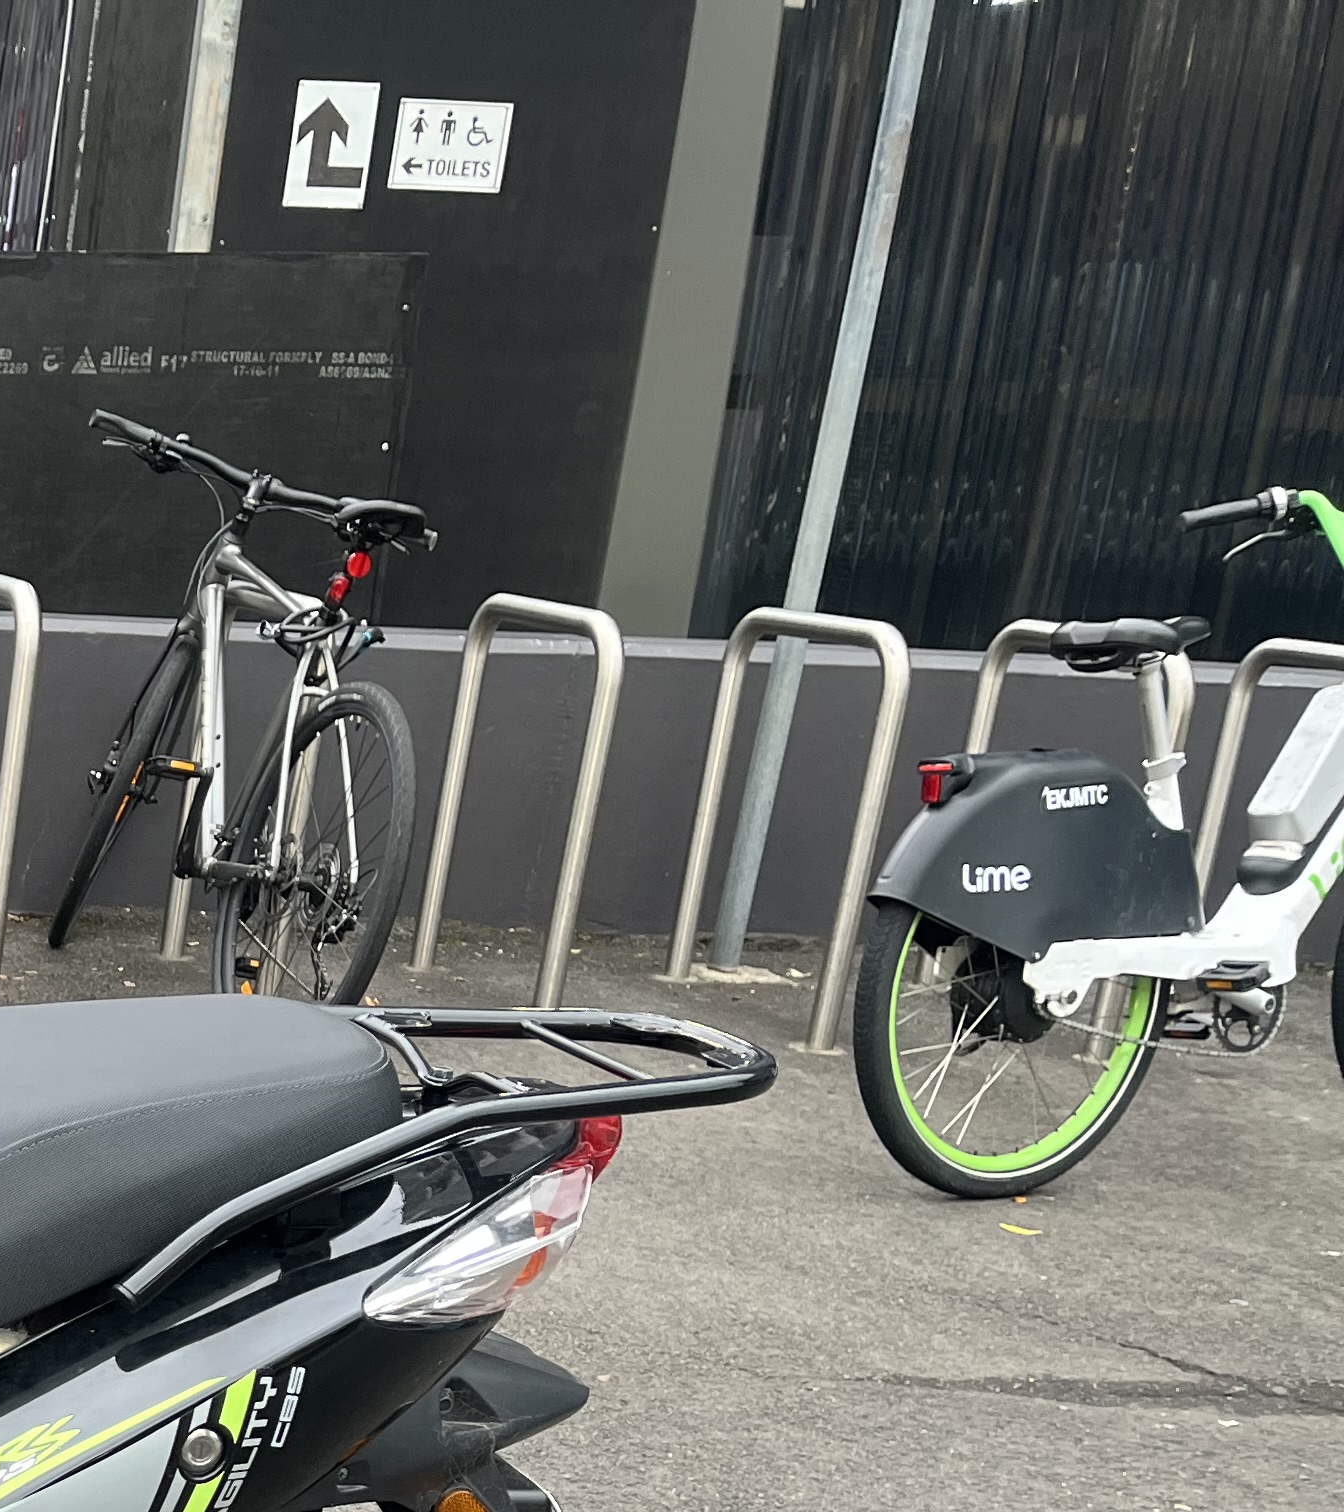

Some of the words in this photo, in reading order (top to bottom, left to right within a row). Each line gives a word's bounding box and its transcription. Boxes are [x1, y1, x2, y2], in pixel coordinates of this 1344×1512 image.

[426, 158, 491, 178] TOILETS
[100, 345, 153, 366] allied
[161, 354, 188, 373] F17
[191, 350, 266, 363] STRUCTURAL
[268, 351, 323, 364] FORMPLY
[331, 351, 355, 364] SS-A
[961, 863, 1032, 893] Lime
[270, 1365, 306, 1449] CBS
